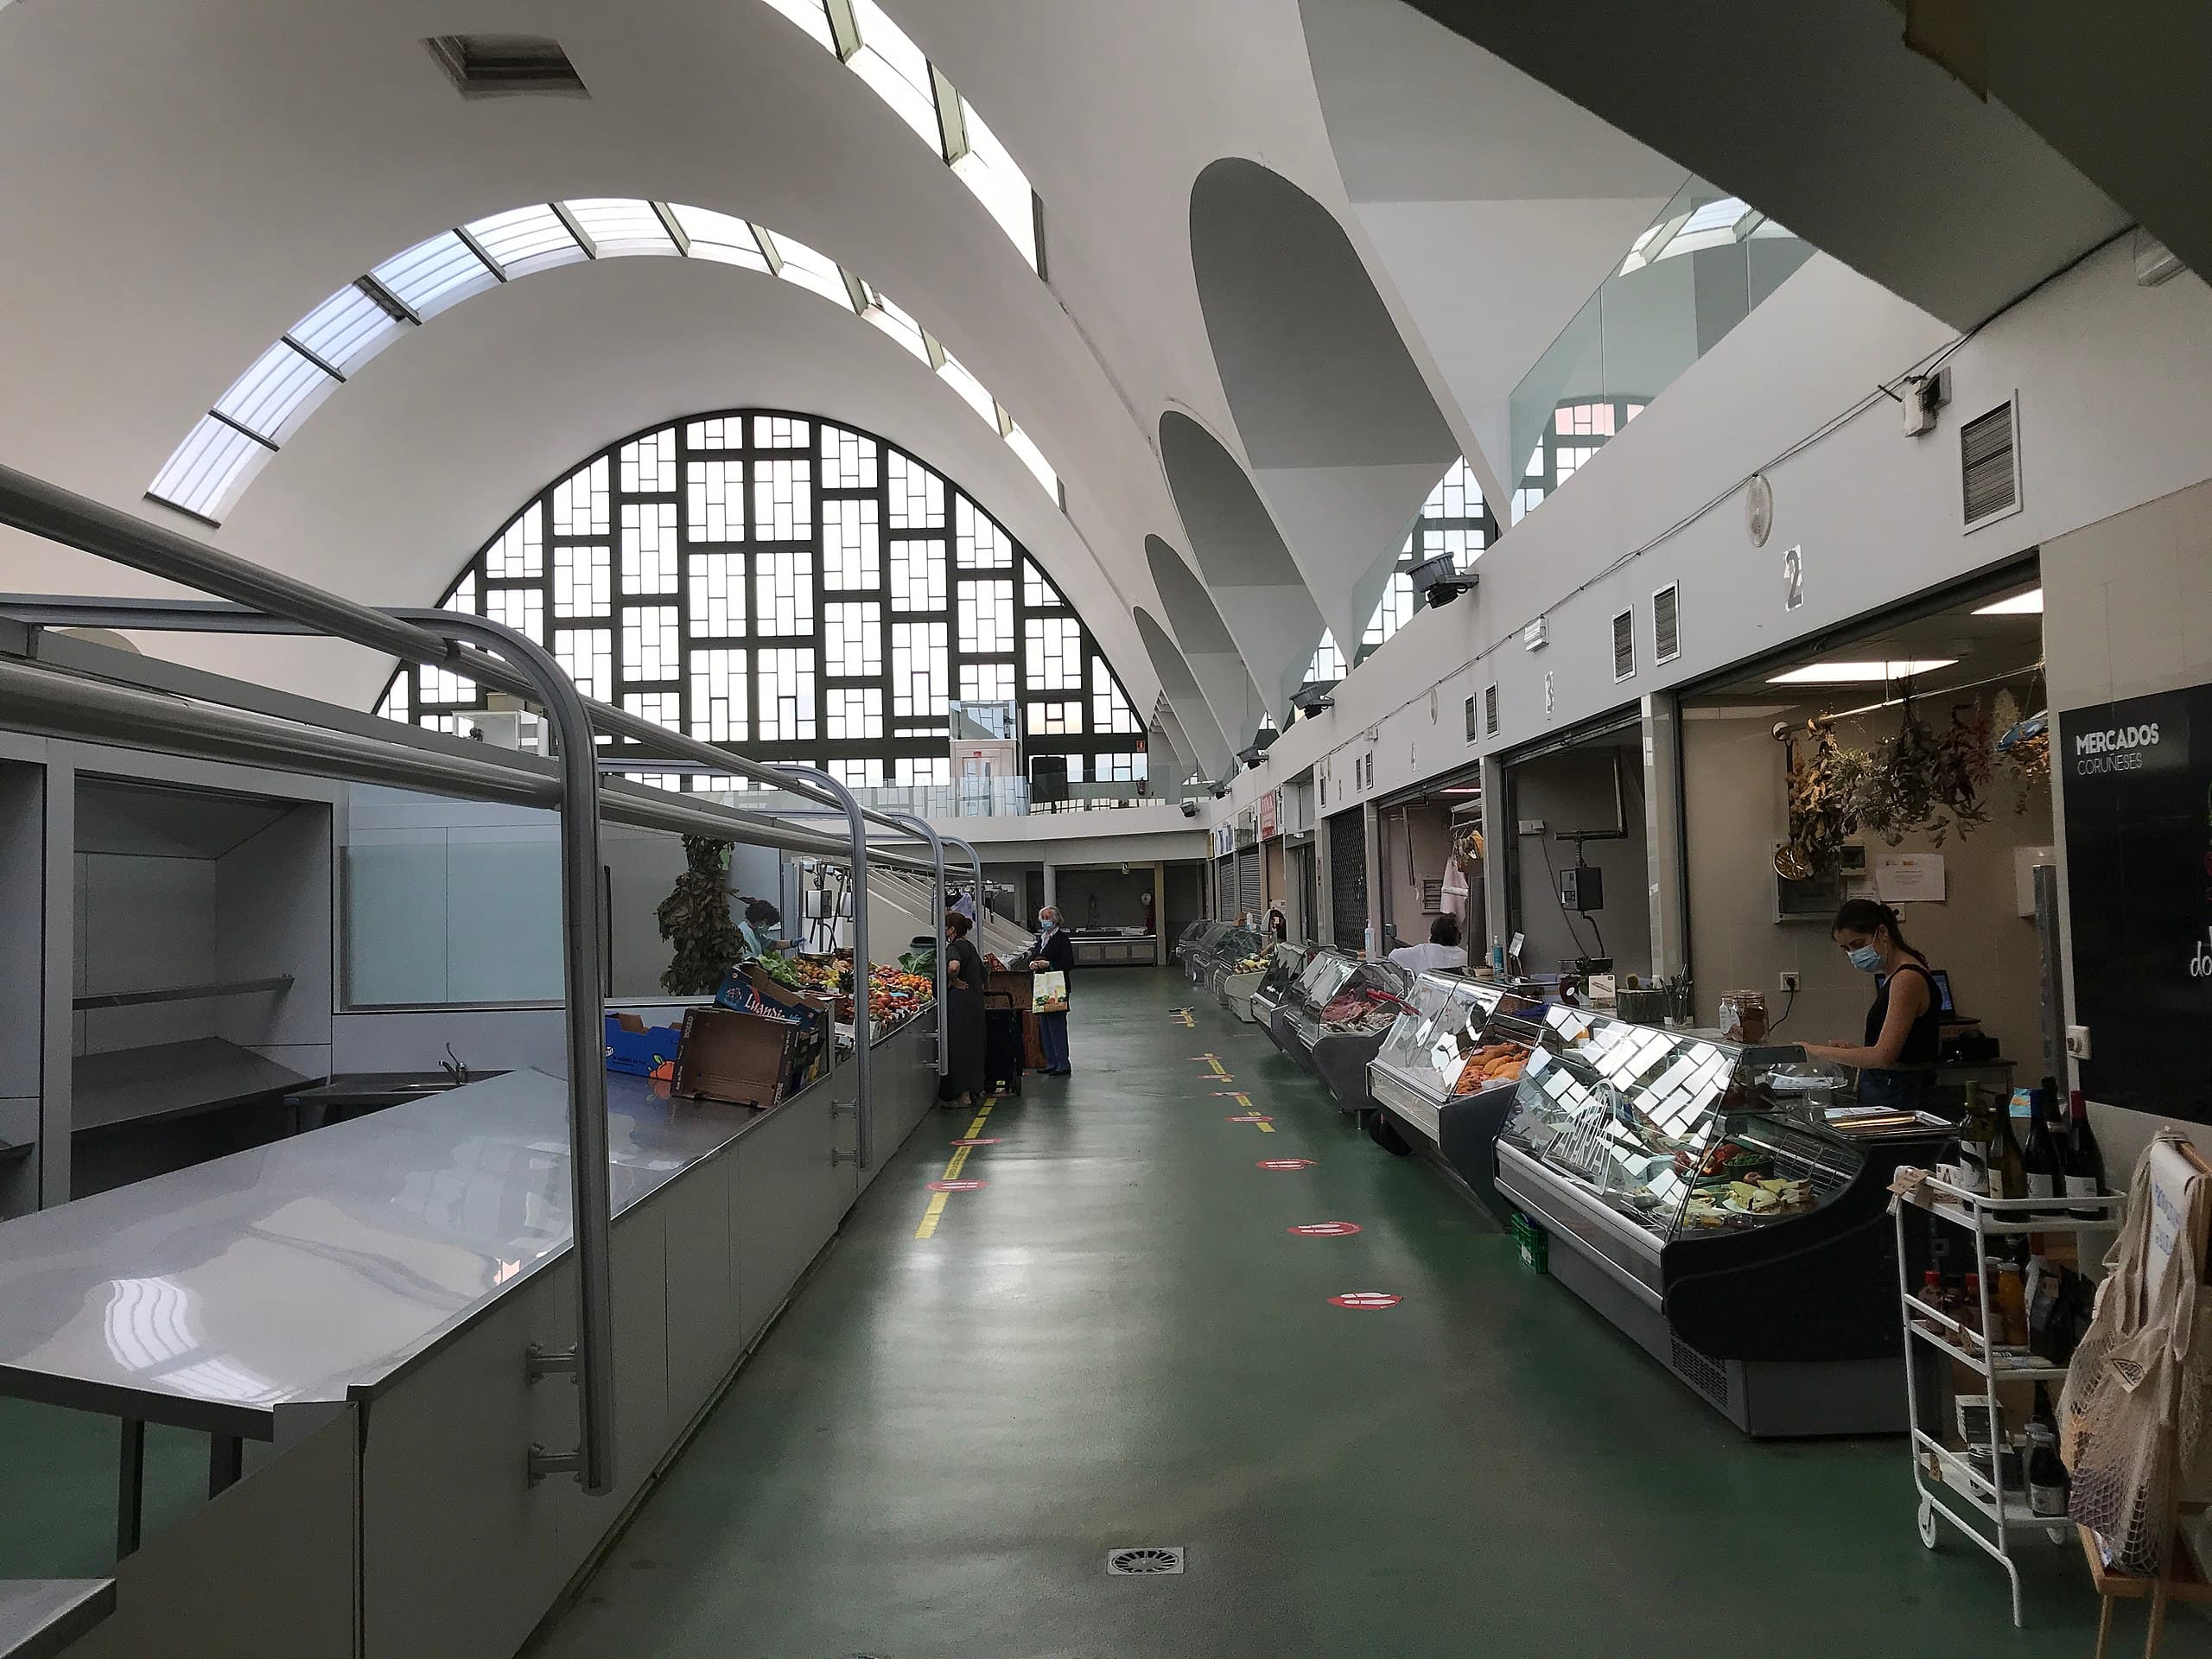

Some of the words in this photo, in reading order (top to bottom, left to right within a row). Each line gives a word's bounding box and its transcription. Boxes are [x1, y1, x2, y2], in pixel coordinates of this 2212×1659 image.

[1786, 550, 1802, 609] 2
[2075, 722, 2160, 756] MERCADOS
[2077, 753, 2143, 776] CORUÑESES
